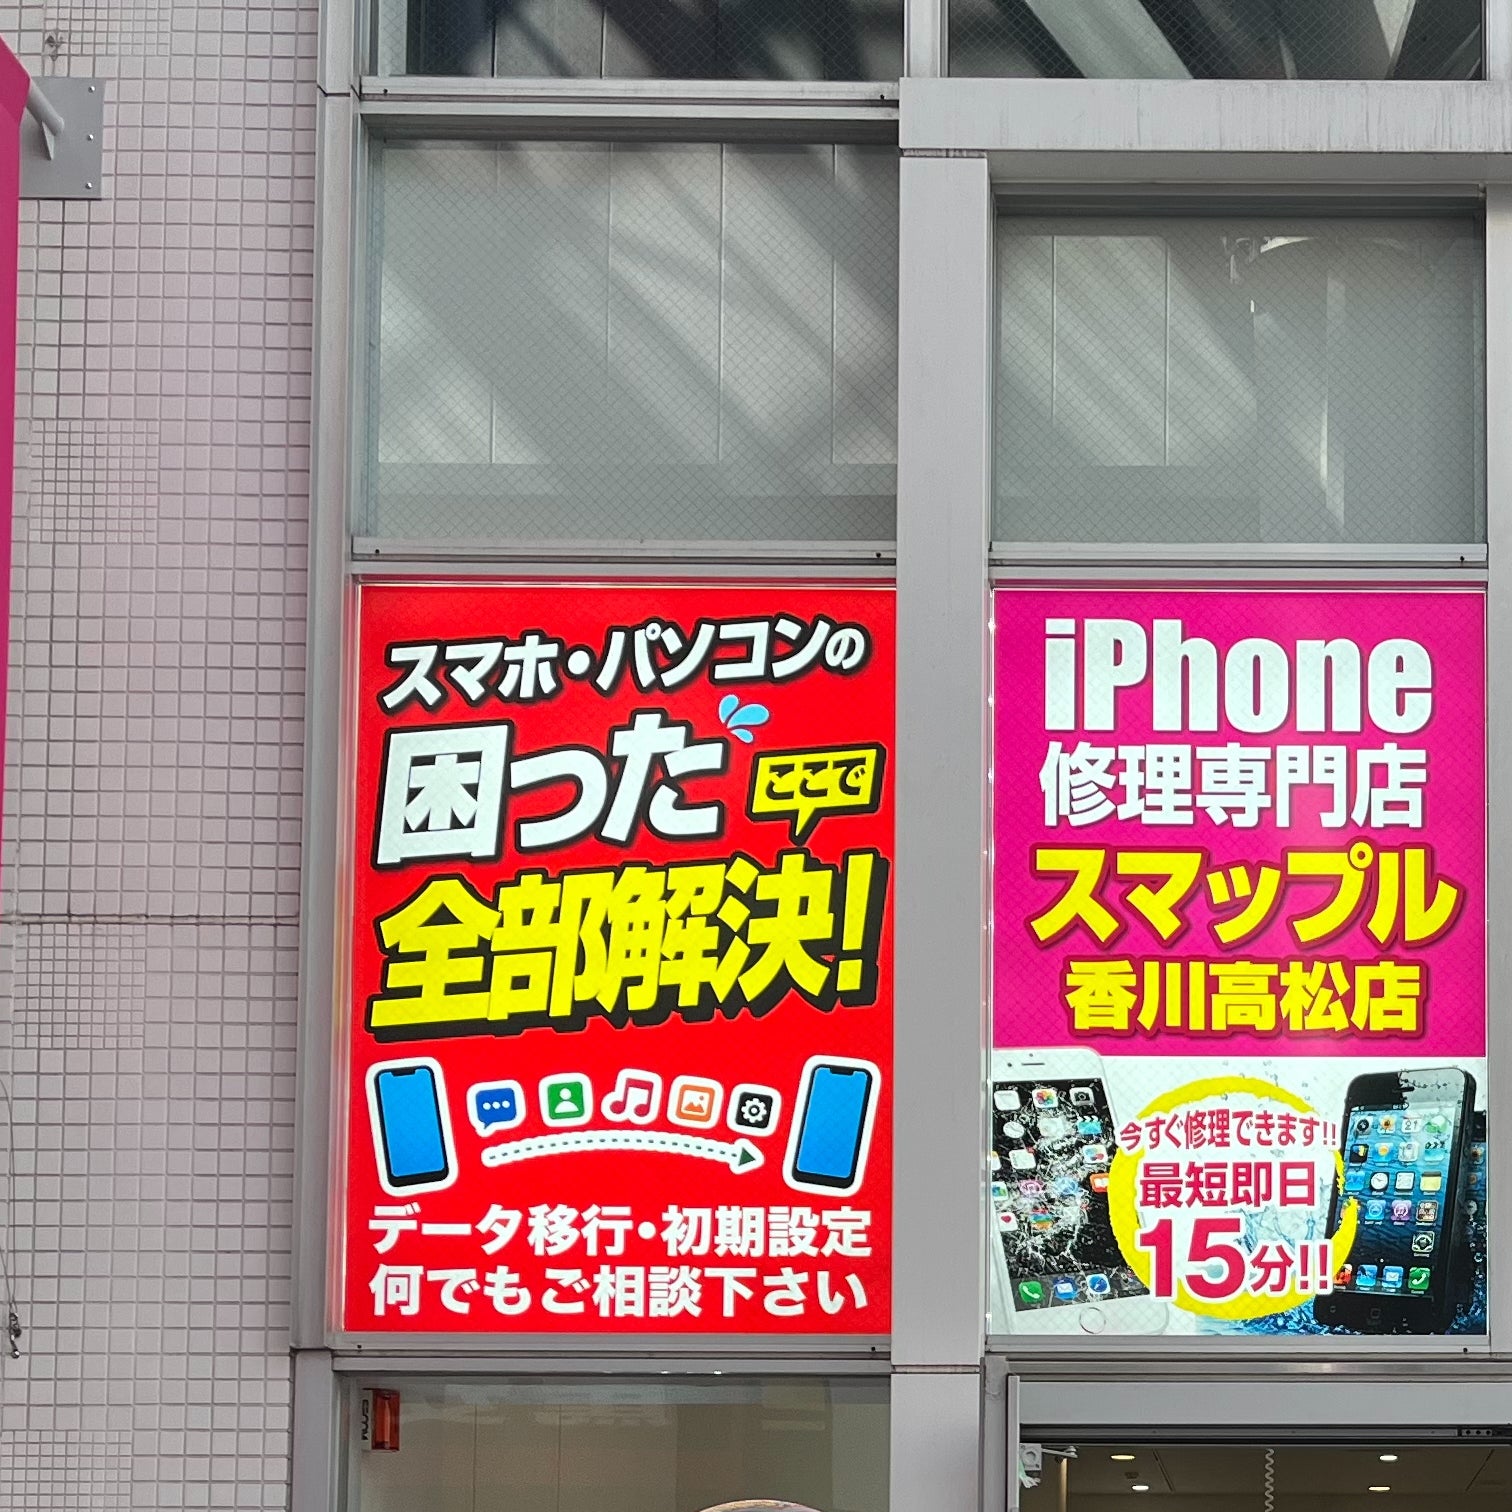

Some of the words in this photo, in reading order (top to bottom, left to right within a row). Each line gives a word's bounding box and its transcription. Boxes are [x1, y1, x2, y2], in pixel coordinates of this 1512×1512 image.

[381, 617, 865, 709] スマホ・パソコンの
[1044, 617, 1433, 734] iPhone
[376, 712, 724, 865] 困った
[765, 755, 868, 802] ここで
[1038, 740, 1428, 828] 修理専門店
[1030, 840, 1459, 945] スマップル
[369, 852, 877, 1028] 全部解決!
[1065, 959, 1422, 1032] 香川高松店
[1119, 1109, 1338, 1152] 今すぐ修理できます!!
[1139, 1161, 1317, 1209] 最短即日
[369, 1202, 873, 1258] データ移行・初期設定
[1139, 1217, 1334, 1299] 15分!!
[369, 1264, 869, 1318] 何でもご相談下さい
